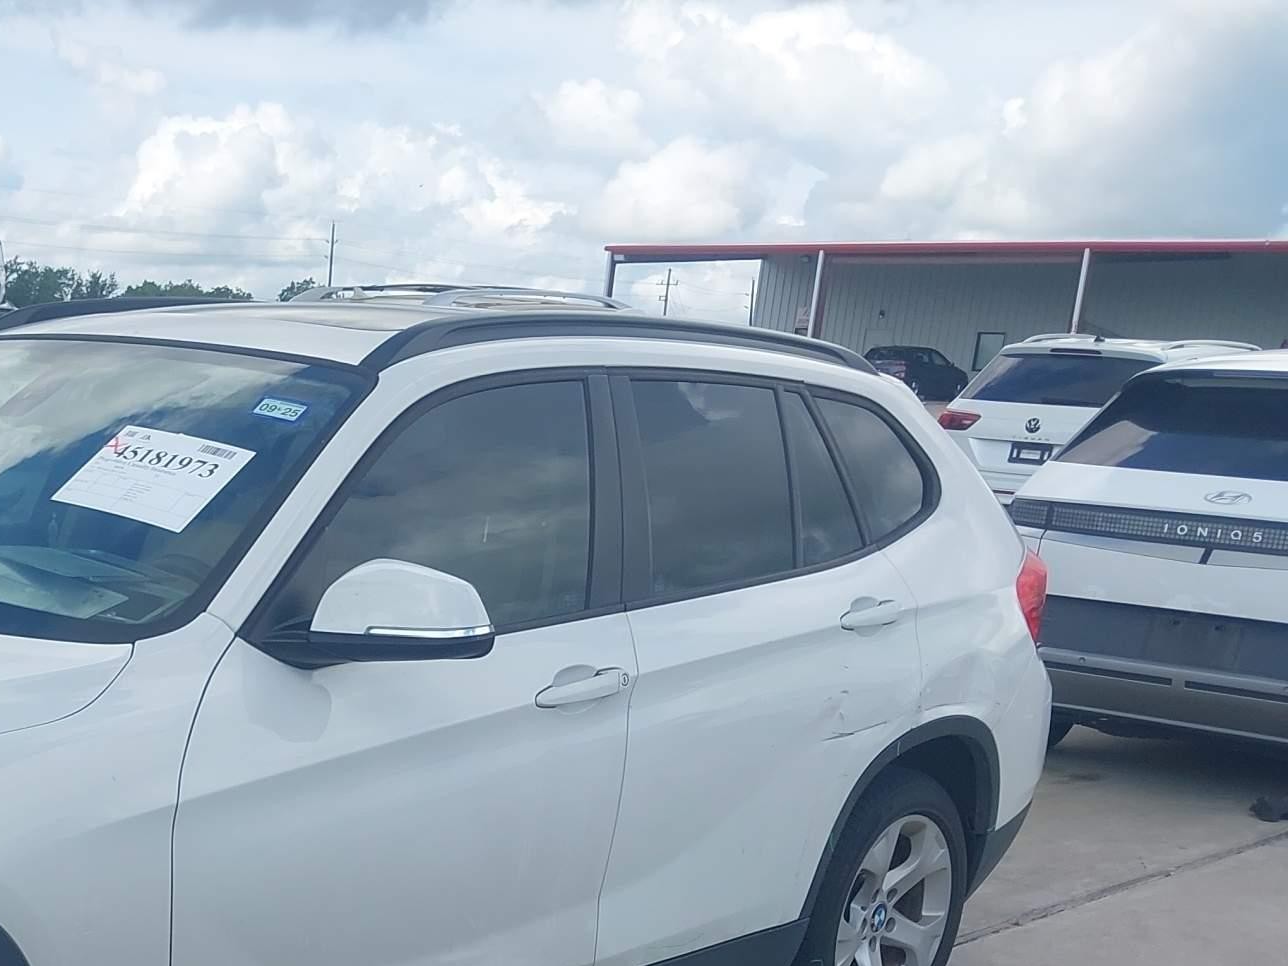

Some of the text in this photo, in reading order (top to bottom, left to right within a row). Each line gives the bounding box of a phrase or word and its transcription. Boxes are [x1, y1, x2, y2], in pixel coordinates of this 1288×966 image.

[259, 403, 278, 413] 09
[280, 407, 301, 418] 25
[114, 445, 220, 479] 45181973
